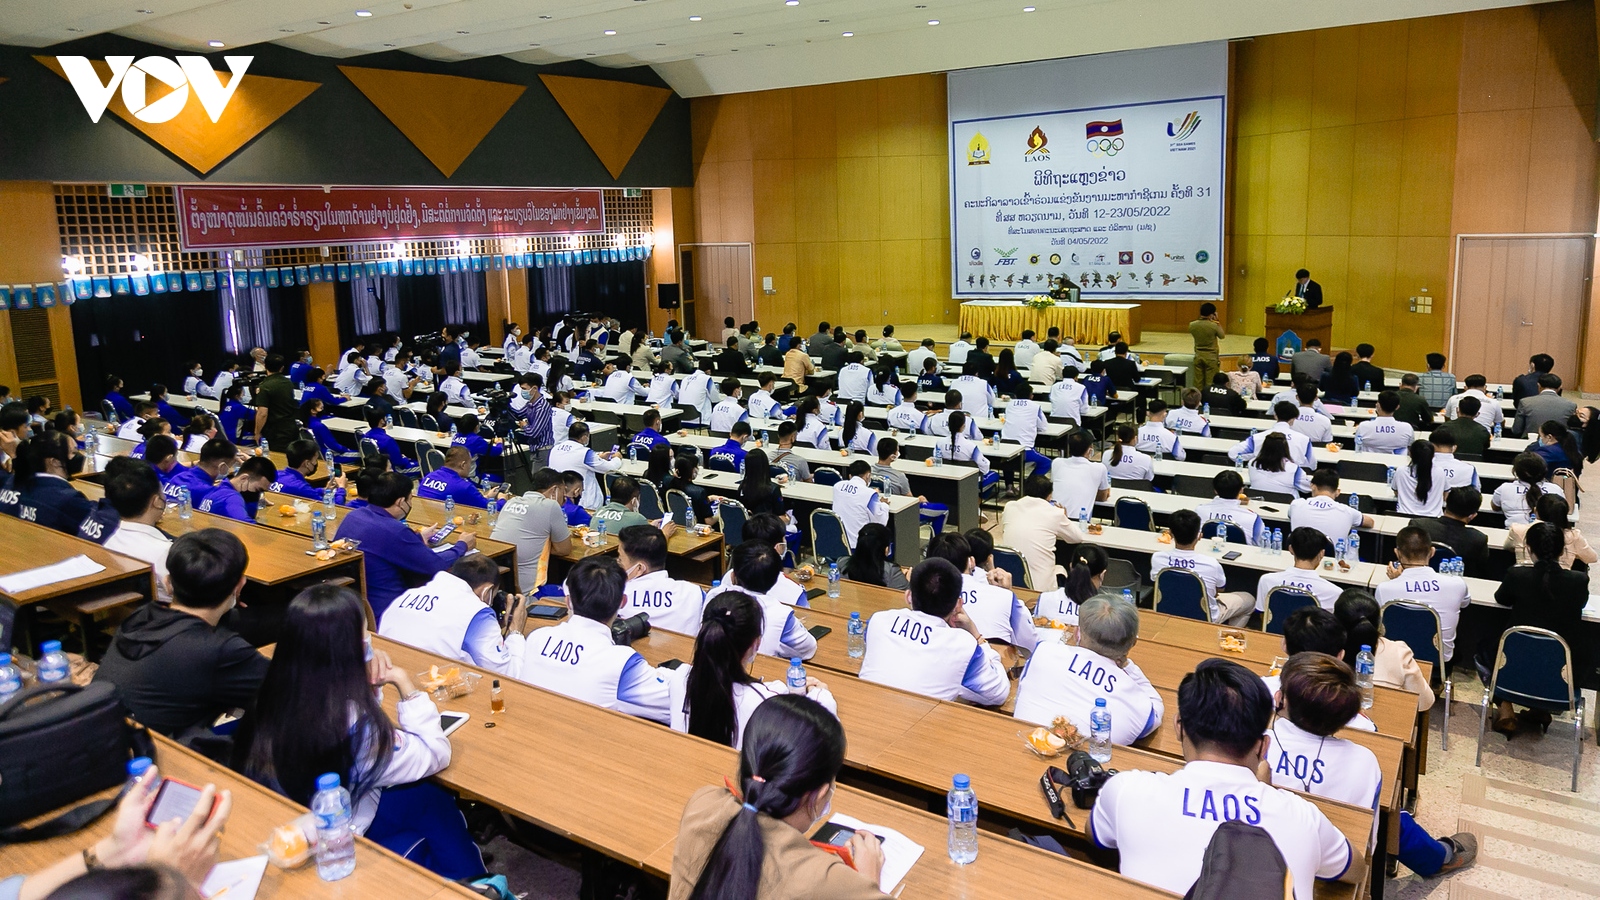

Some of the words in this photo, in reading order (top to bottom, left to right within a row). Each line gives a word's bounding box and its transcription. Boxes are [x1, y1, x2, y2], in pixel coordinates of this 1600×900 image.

[1024, 154, 1051, 163] LAOS
[1196, 187, 1211, 197] 31
[1093, 205, 1171, 219] 12-23/05/2022
[1067, 236, 1109, 245] 04/05/2022
[995, 257, 1018, 266] FBT
[848, 363, 859, 371] LAOS
[1058, 383, 1073, 391] LAOS
[1210, 386, 1228, 395] LAOS
[751, 398, 762, 407] LAOS
[1013, 399, 1028, 407] LAOS
[717, 405, 730, 414] LAOS
[897, 412, 911, 421] LAOS
[1375, 425, 1396, 434] LAOS
[635, 435, 654, 445] LAOS
[1142, 433, 1160, 443] LAOS
[423, 477, 447, 492] LAOS
[841, 483, 859, 495] LAOS
[20, 503, 38, 522] LAOS
[504, 501, 528, 515] LAOS
[596, 508, 624, 521] LAOS
[81, 516, 105, 539] LAOS
[1168, 555, 1196, 569] LAOS
[1405, 579, 1440, 593] LAOS
[398, 592, 439, 613] LAOS
[633, 589, 673, 608] LAOS
[890, 615, 933, 646] LAOS
[540, 635, 584, 666] LAOS
[1067, 652, 1118, 693] LAOS
[1275, 750, 1326, 785] AOS
[1182, 786, 1262, 826] LAOS
